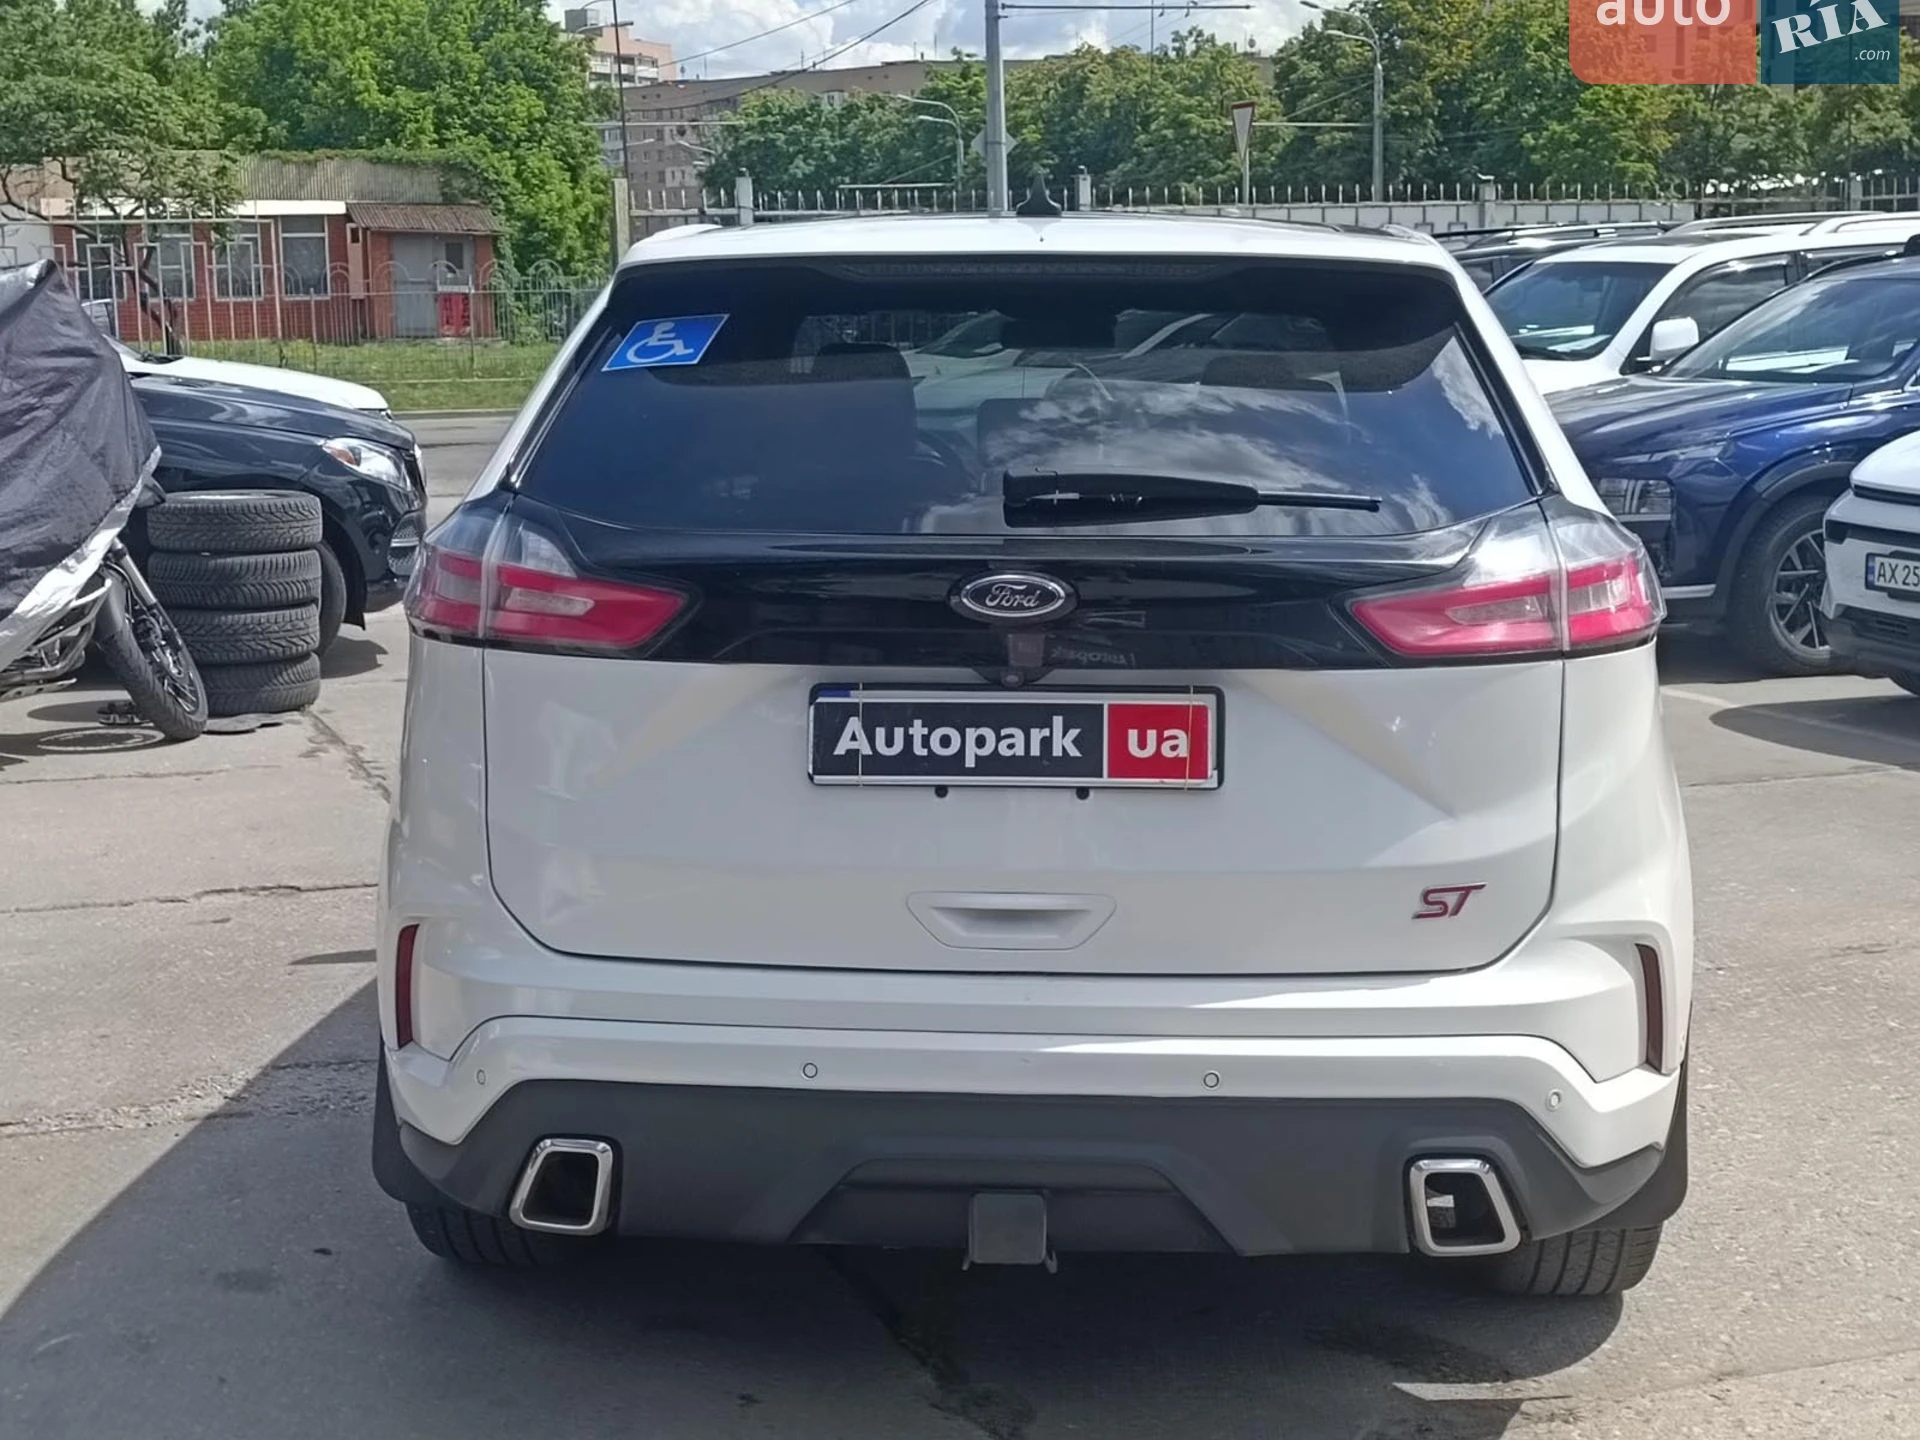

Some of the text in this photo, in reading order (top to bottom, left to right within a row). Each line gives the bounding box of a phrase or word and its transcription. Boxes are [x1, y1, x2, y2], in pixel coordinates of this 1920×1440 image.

[1877, 561, 1899, 585] AX
[985, 583, 1041, 608] Ford
[833, 715, 1189, 768] Autopark ua
[1411, 882, 1488, 920] ST
